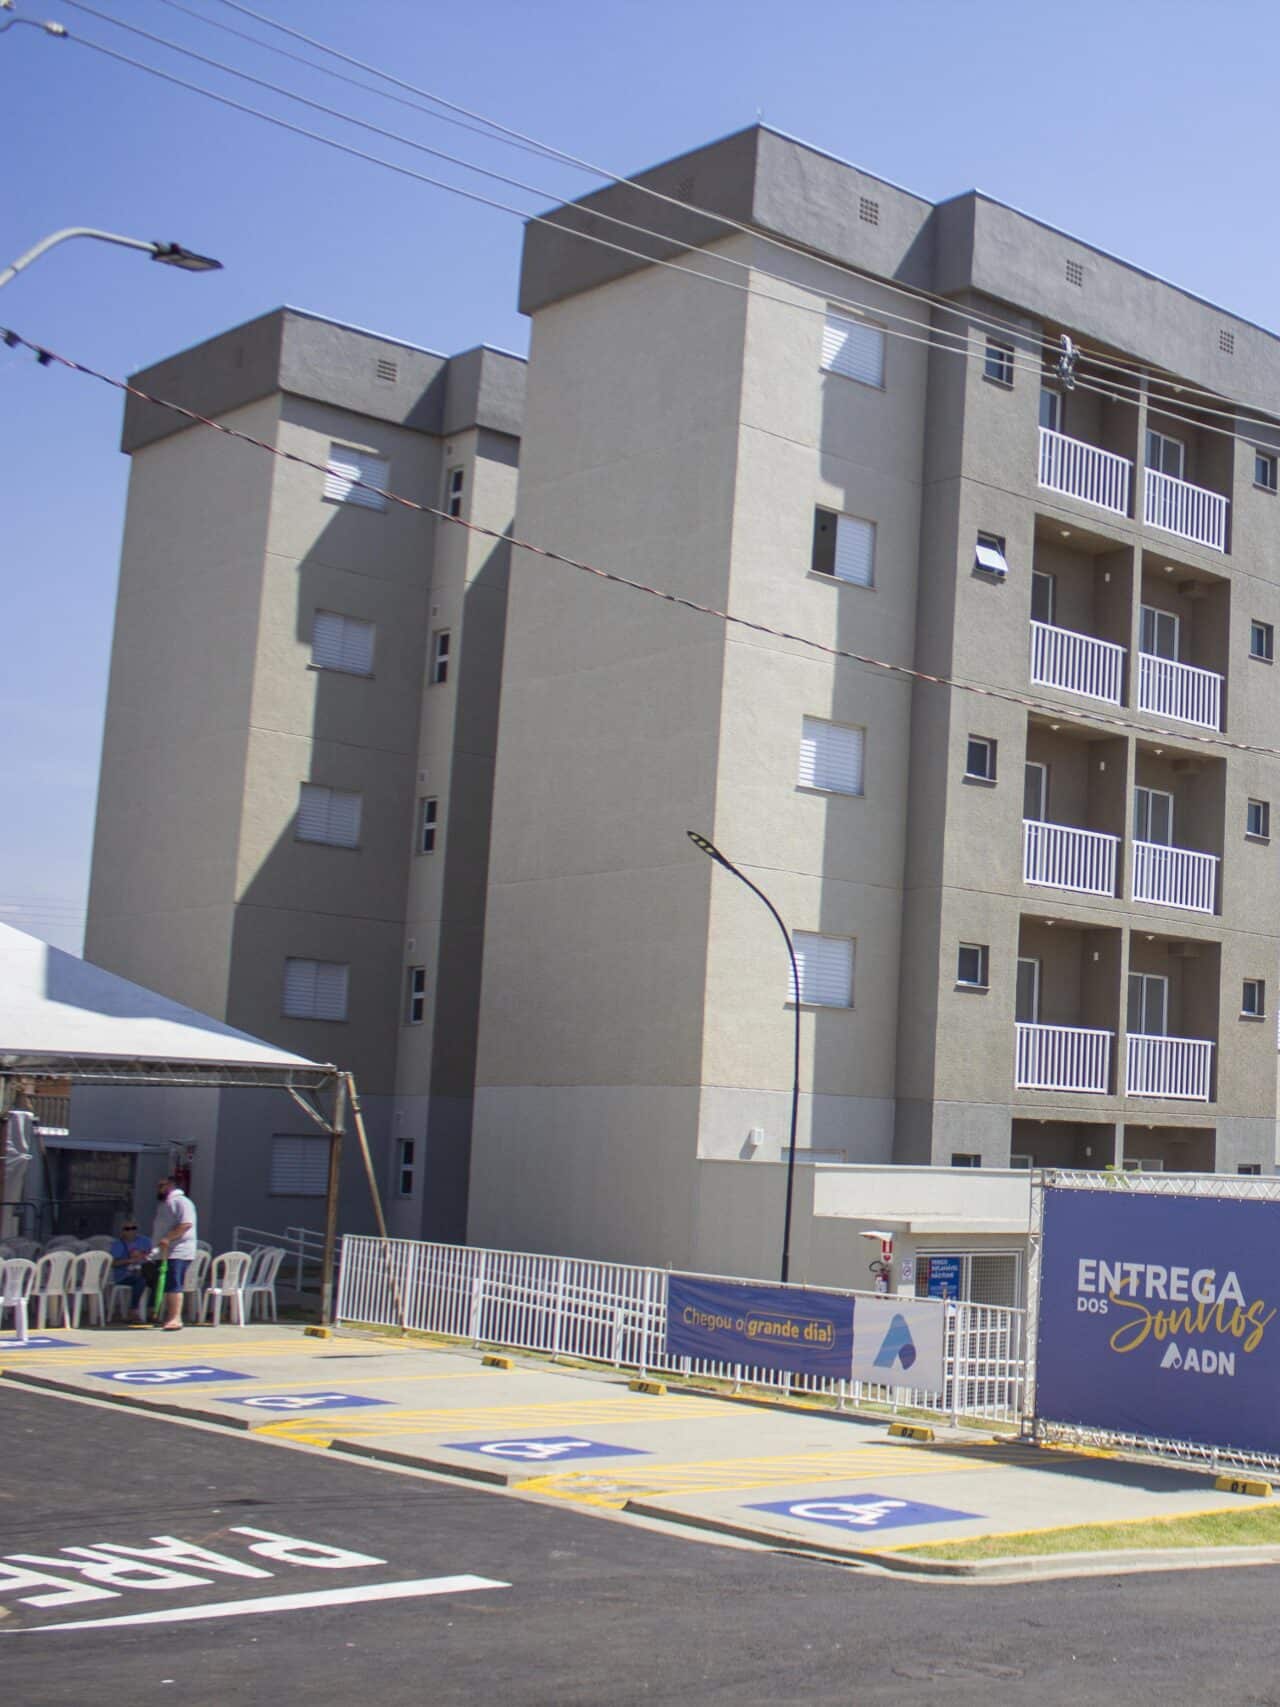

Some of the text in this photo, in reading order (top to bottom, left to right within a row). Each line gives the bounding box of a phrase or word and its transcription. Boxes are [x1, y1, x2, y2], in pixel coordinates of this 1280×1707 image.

[1077, 1258, 1246, 1307] ENTREGA
[683, 1306, 833, 1342] Chegou o grande dia!
[1076, 1268, 1277, 1353] DOS Sonhos
[1183, 1347, 1236, 1377] ADN
